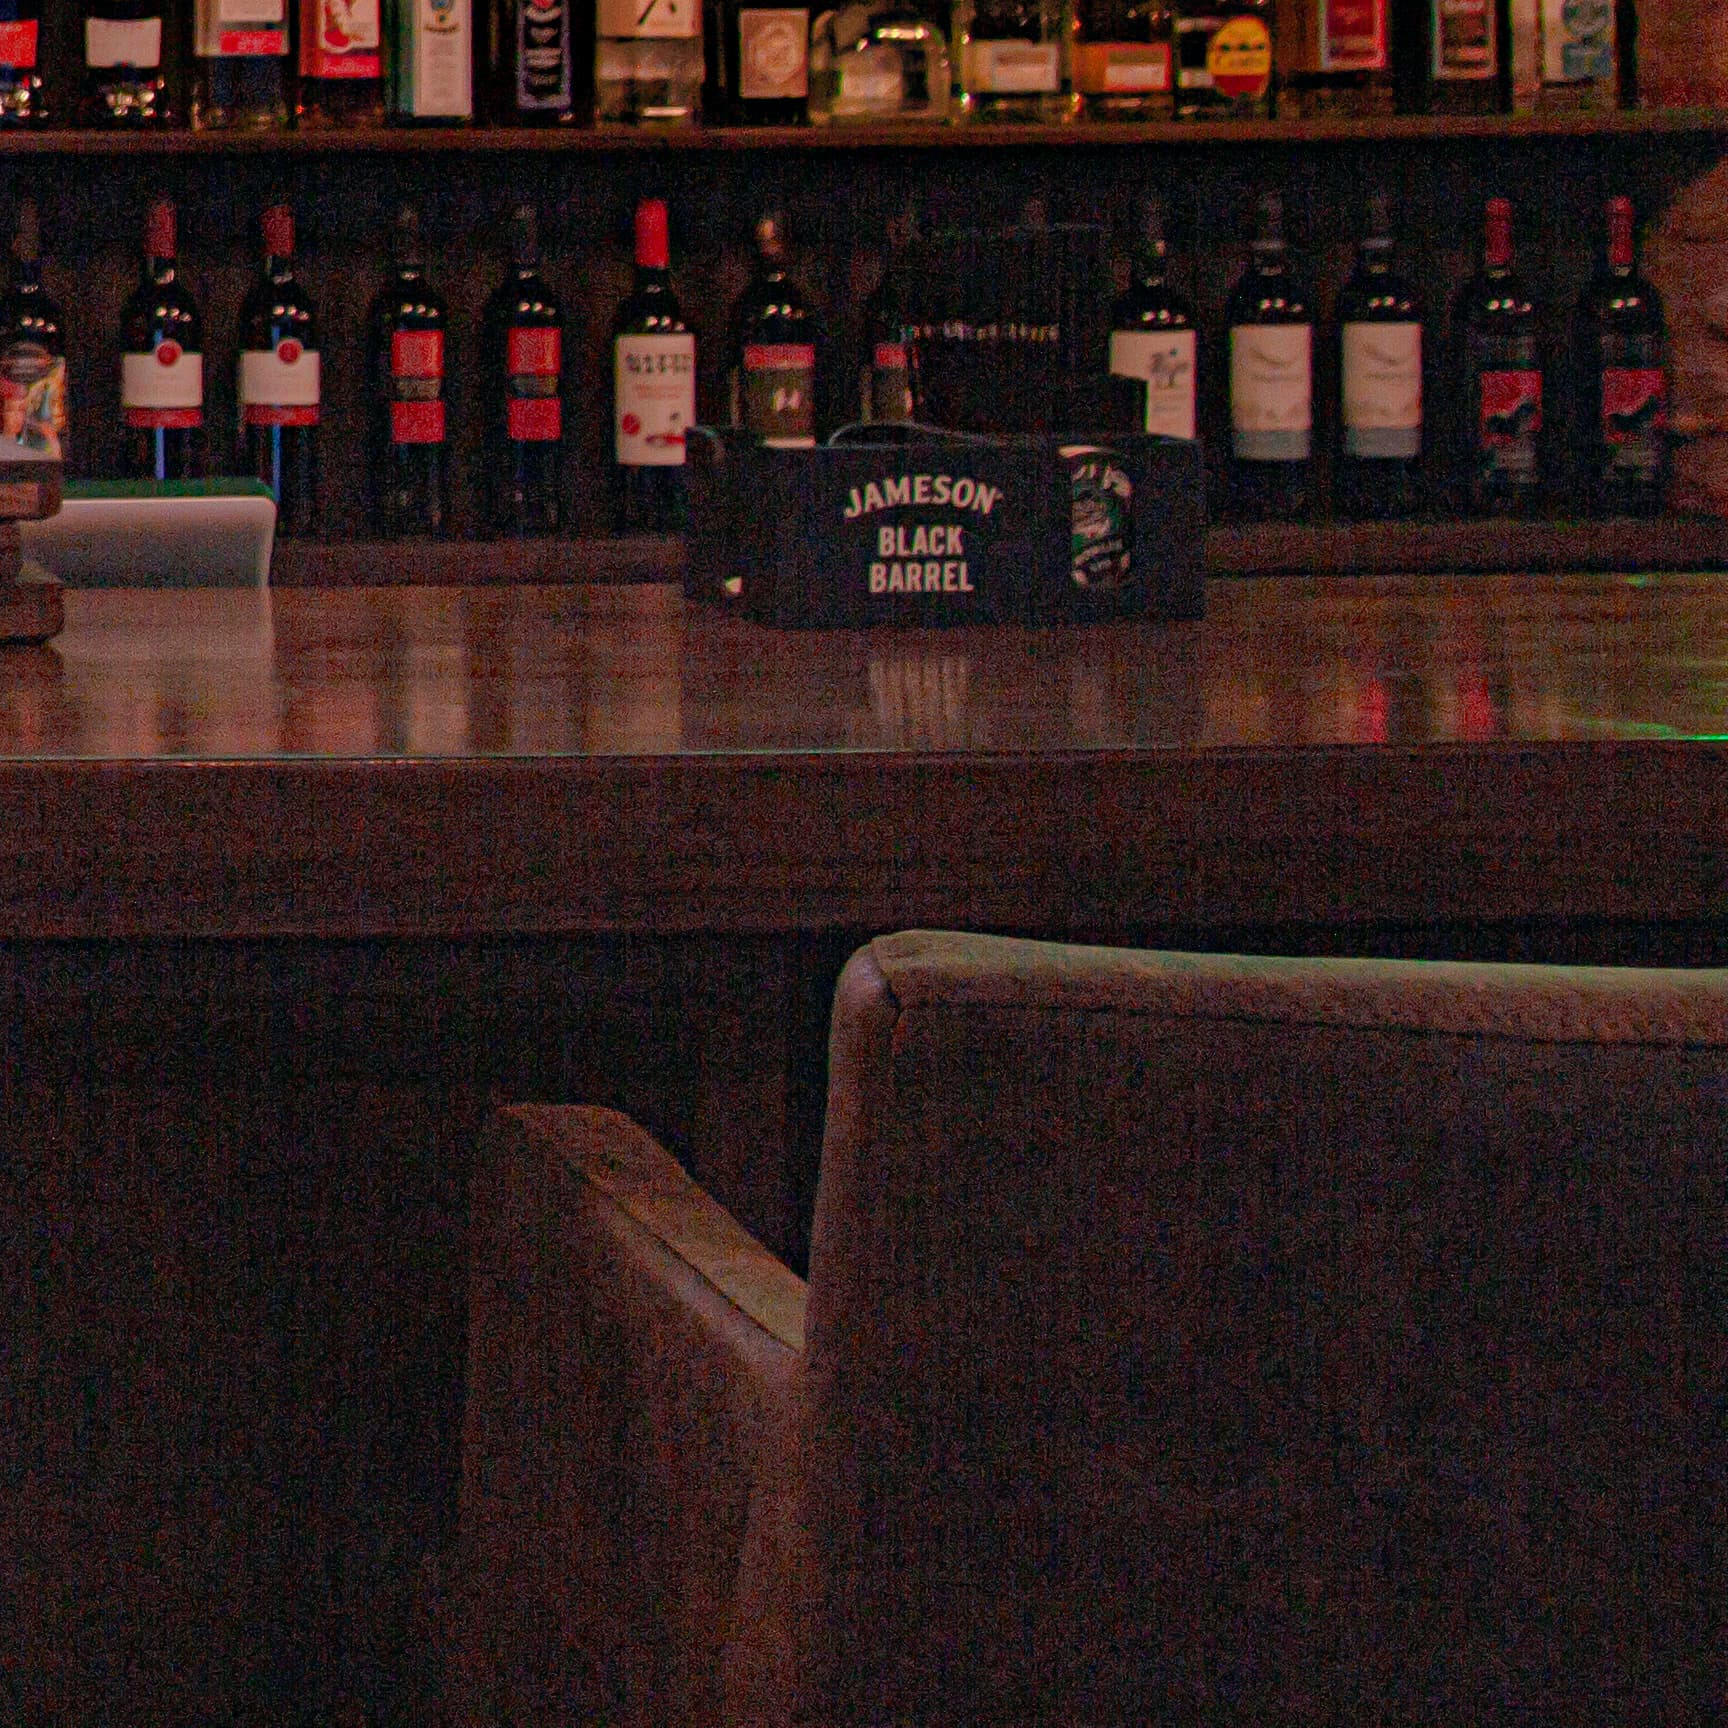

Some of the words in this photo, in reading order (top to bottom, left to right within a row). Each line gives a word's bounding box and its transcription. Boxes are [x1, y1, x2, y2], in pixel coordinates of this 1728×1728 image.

[845, 474, 997, 519] JAMESON
[878, 525, 964, 558] BLACK
[869, 561, 975, 593] BARREL
